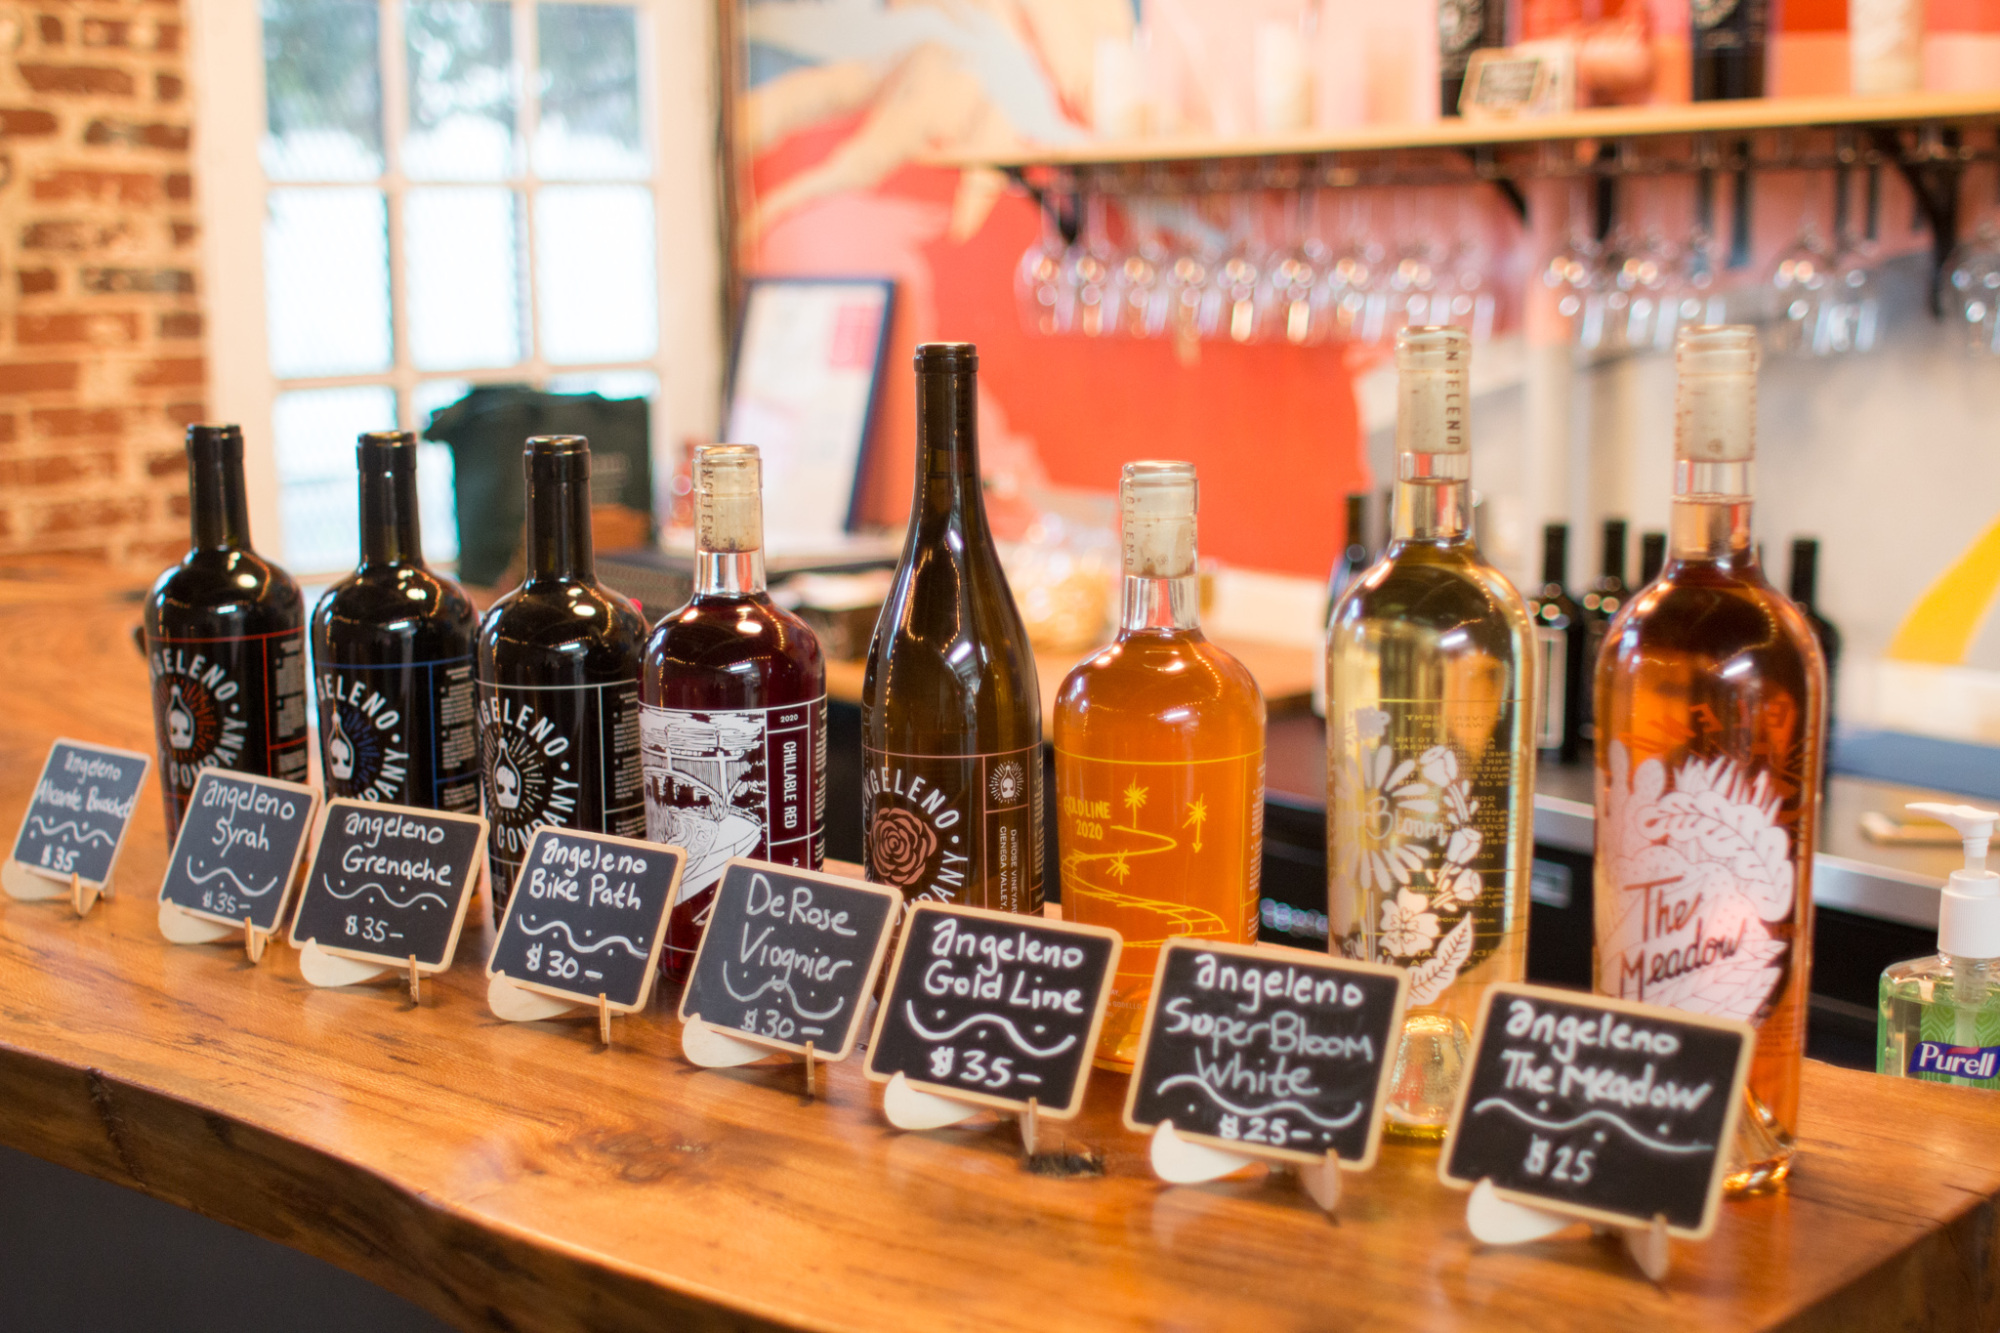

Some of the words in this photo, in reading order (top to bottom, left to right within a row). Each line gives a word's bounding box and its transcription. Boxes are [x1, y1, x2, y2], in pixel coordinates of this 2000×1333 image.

[780, 713, 799, 723] 2020
[783, 741, 797, 803] CHILLABLE
[203, 780, 296, 826] angeleno
[784, 805, 797, 829] RED
[212, 817, 270, 857] Syrah
[345, 812, 445, 849] angeleno
[1076, 819, 1104, 841] 2020
[342, 845, 452, 887] Grenache
[541, 837, 647, 876] angeleno
[529, 868, 580, 902] Bike
[589, 873, 642, 910] Path
[1623, 875, 1703, 943] The
[739, 921, 853, 989] Viognier
[931, 918, 1084, 977] angeleno
[1620, 918, 1747, 1002] Meadow
[924, 960, 1001, 1000] Gold
[1009, 969, 1084, 1014] Line
[1195, 954, 1363, 1014] angeleno
[1505, 999, 1680, 1064] angeleno
[1195, 1046, 1320, 1097] White
[1500, 1049, 1555, 1093] The
[1919, 1043, 1996, 1077] Purell
[1523, 1133, 1596, 1183] $25
